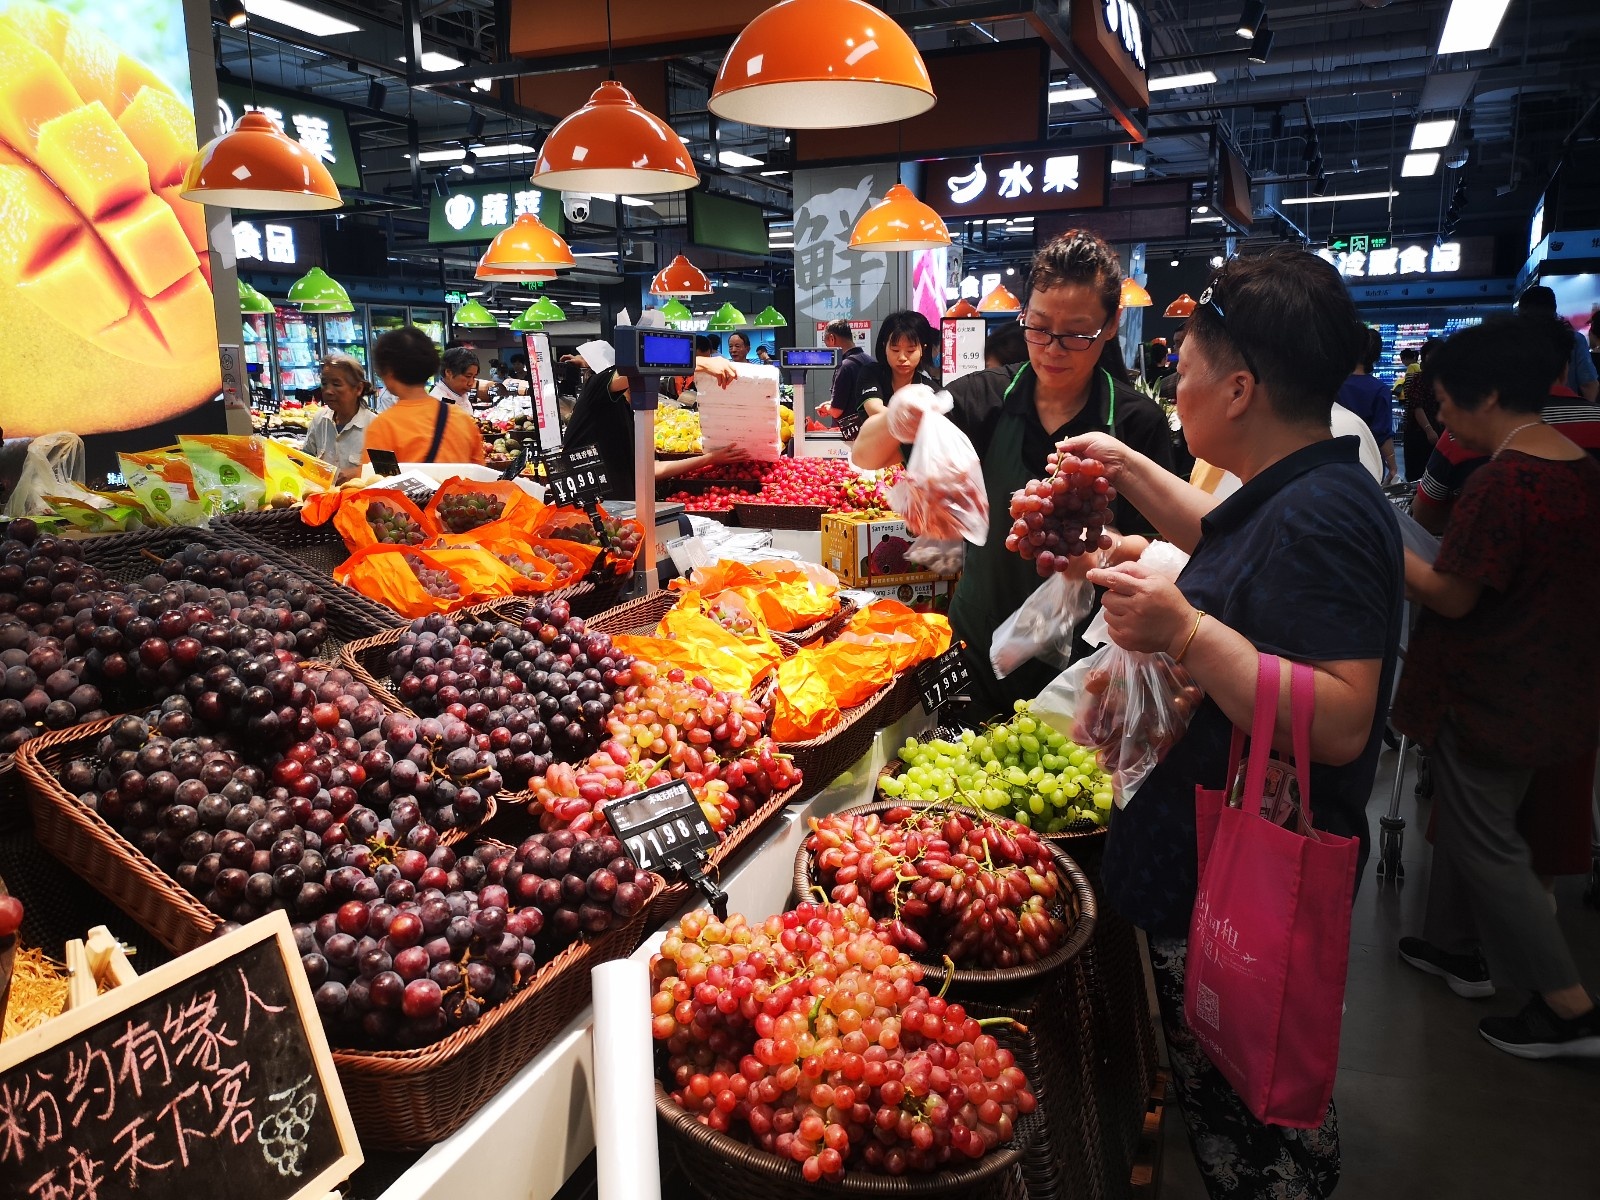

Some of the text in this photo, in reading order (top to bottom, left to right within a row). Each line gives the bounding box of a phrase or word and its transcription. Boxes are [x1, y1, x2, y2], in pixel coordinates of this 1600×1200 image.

[998, 155, 1080, 199] 水果
[231, 221, 296, 264] 食品
[963, 352, 980, 360] 6.99
